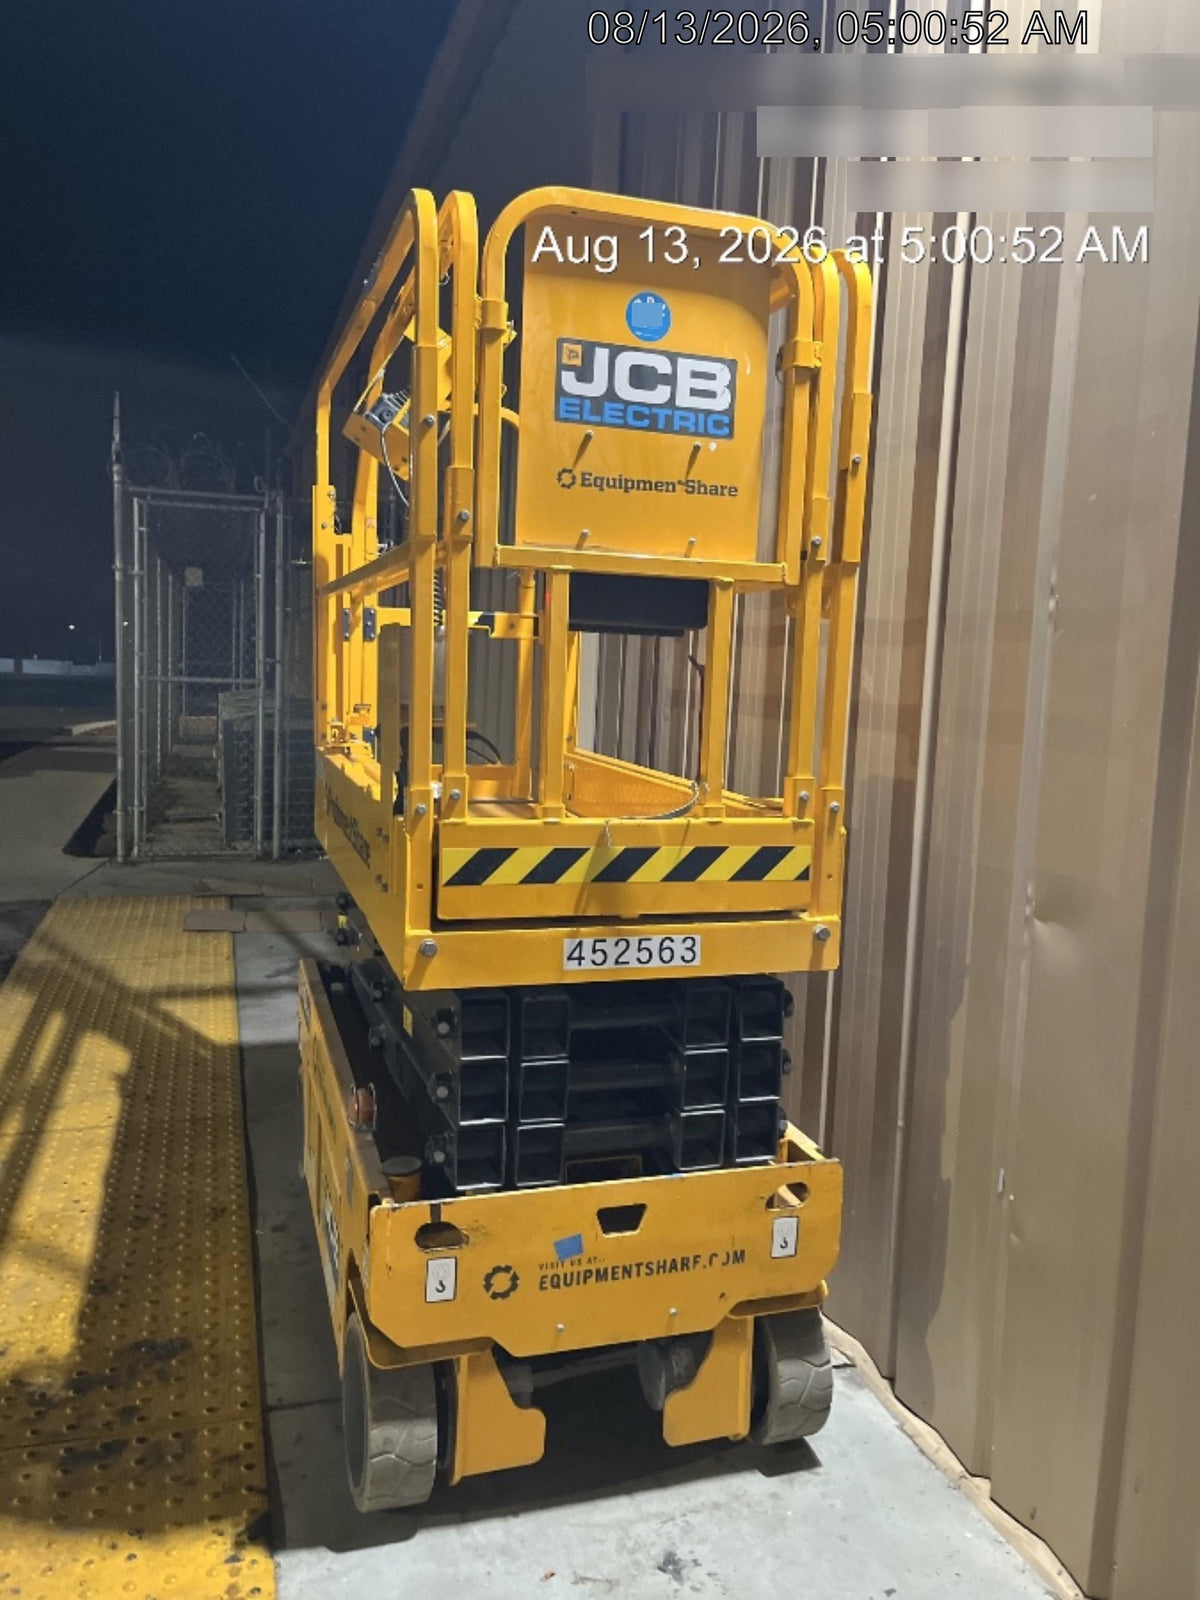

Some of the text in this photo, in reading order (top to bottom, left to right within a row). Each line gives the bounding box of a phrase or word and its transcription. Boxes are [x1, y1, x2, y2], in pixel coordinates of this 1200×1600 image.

[561, 346, 731, 411] JCB
[558, 397, 730, 436] ELECTRIC
[566, 936, 697, 967] 452563
